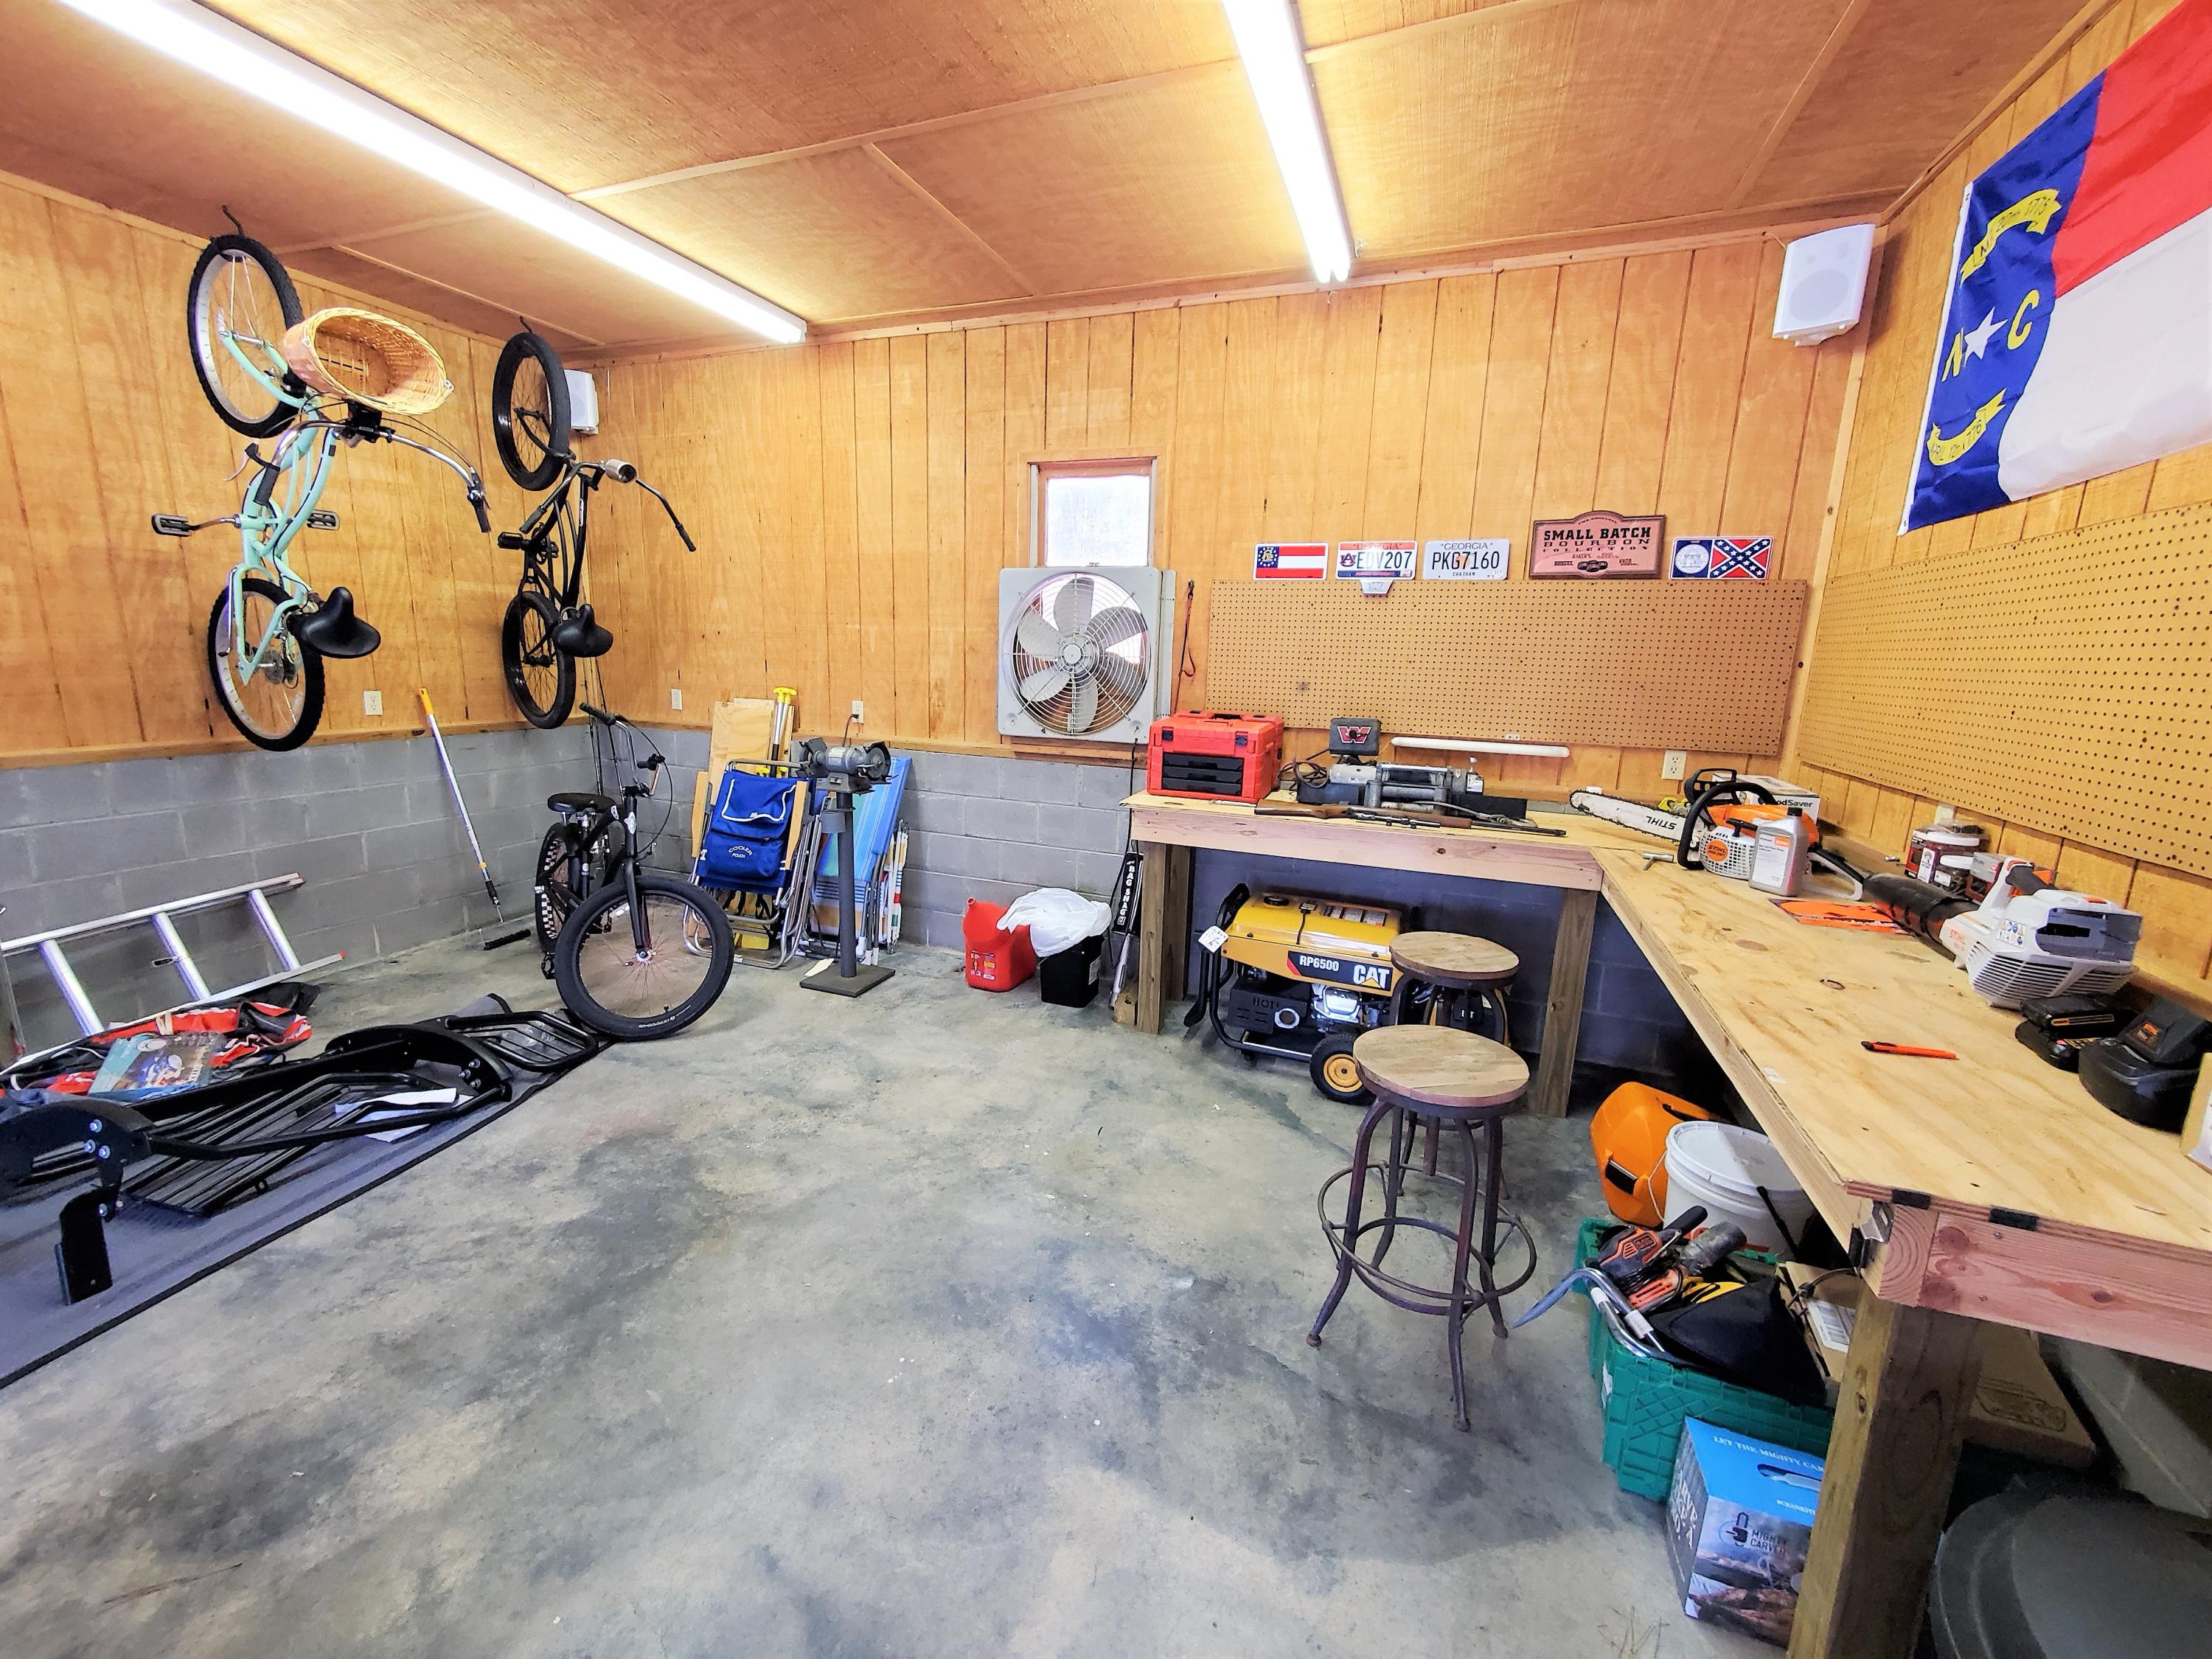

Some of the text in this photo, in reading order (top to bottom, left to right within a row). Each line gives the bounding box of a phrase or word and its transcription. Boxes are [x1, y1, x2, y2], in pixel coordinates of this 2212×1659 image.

[2006, 289, 2040, 349] C
[1543, 526, 1652, 541] SMALL BATCH
[1444, 542, 1489, 550] GEORGIA
[1543, 538, 1650, 547] BOURBON
[1432, 551, 1500, 570] PKG7160
[1776, 799, 1813, 808] odSaver
[1646, 815, 1677, 830] STIHL
[728, 845, 753, 856] COOLER
[1708, 844, 1727, 854] STIHL
[1125, 865, 1135, 887] BAG
[1299, 955, 1340, 972] RP6500
[1353, 964, 1390, 989] CAT
[1714, 1436, 1733, 1447] LET
[1736, 1441, 1757, 1453] THE
[1759, 1448, 1802, 1466] MIGHTY
